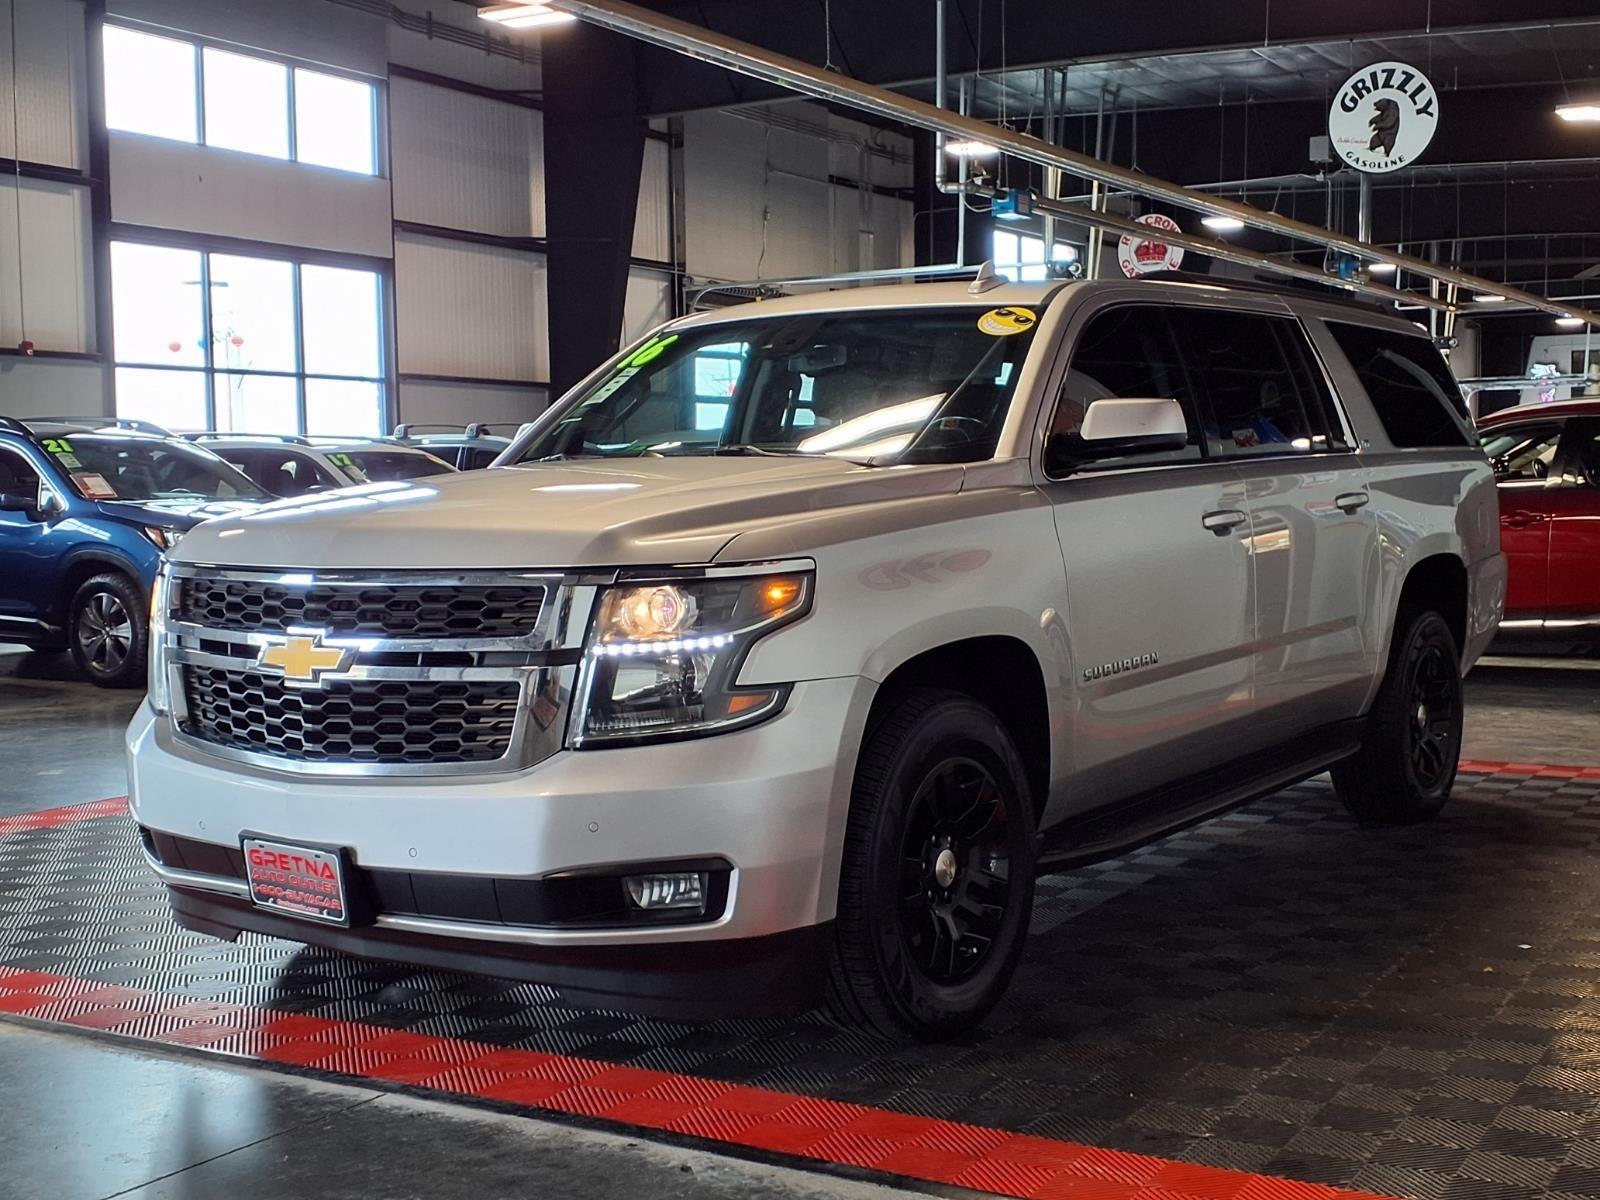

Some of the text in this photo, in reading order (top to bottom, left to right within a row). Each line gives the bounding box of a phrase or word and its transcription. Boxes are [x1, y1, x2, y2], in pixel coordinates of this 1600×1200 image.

[1340, 68, 1434, 118] GRIZZLY
[1345, 151, 1406, 169] GASOLINE
[42, 439, 74, 453] 21
[327, 453, 351, 467] 17
[1083, 651, 1159, 681] SUBURBAN
[248, 848, 336, 880] GRETNA
[251, 868, 338, 894] AUTO OUTLET
